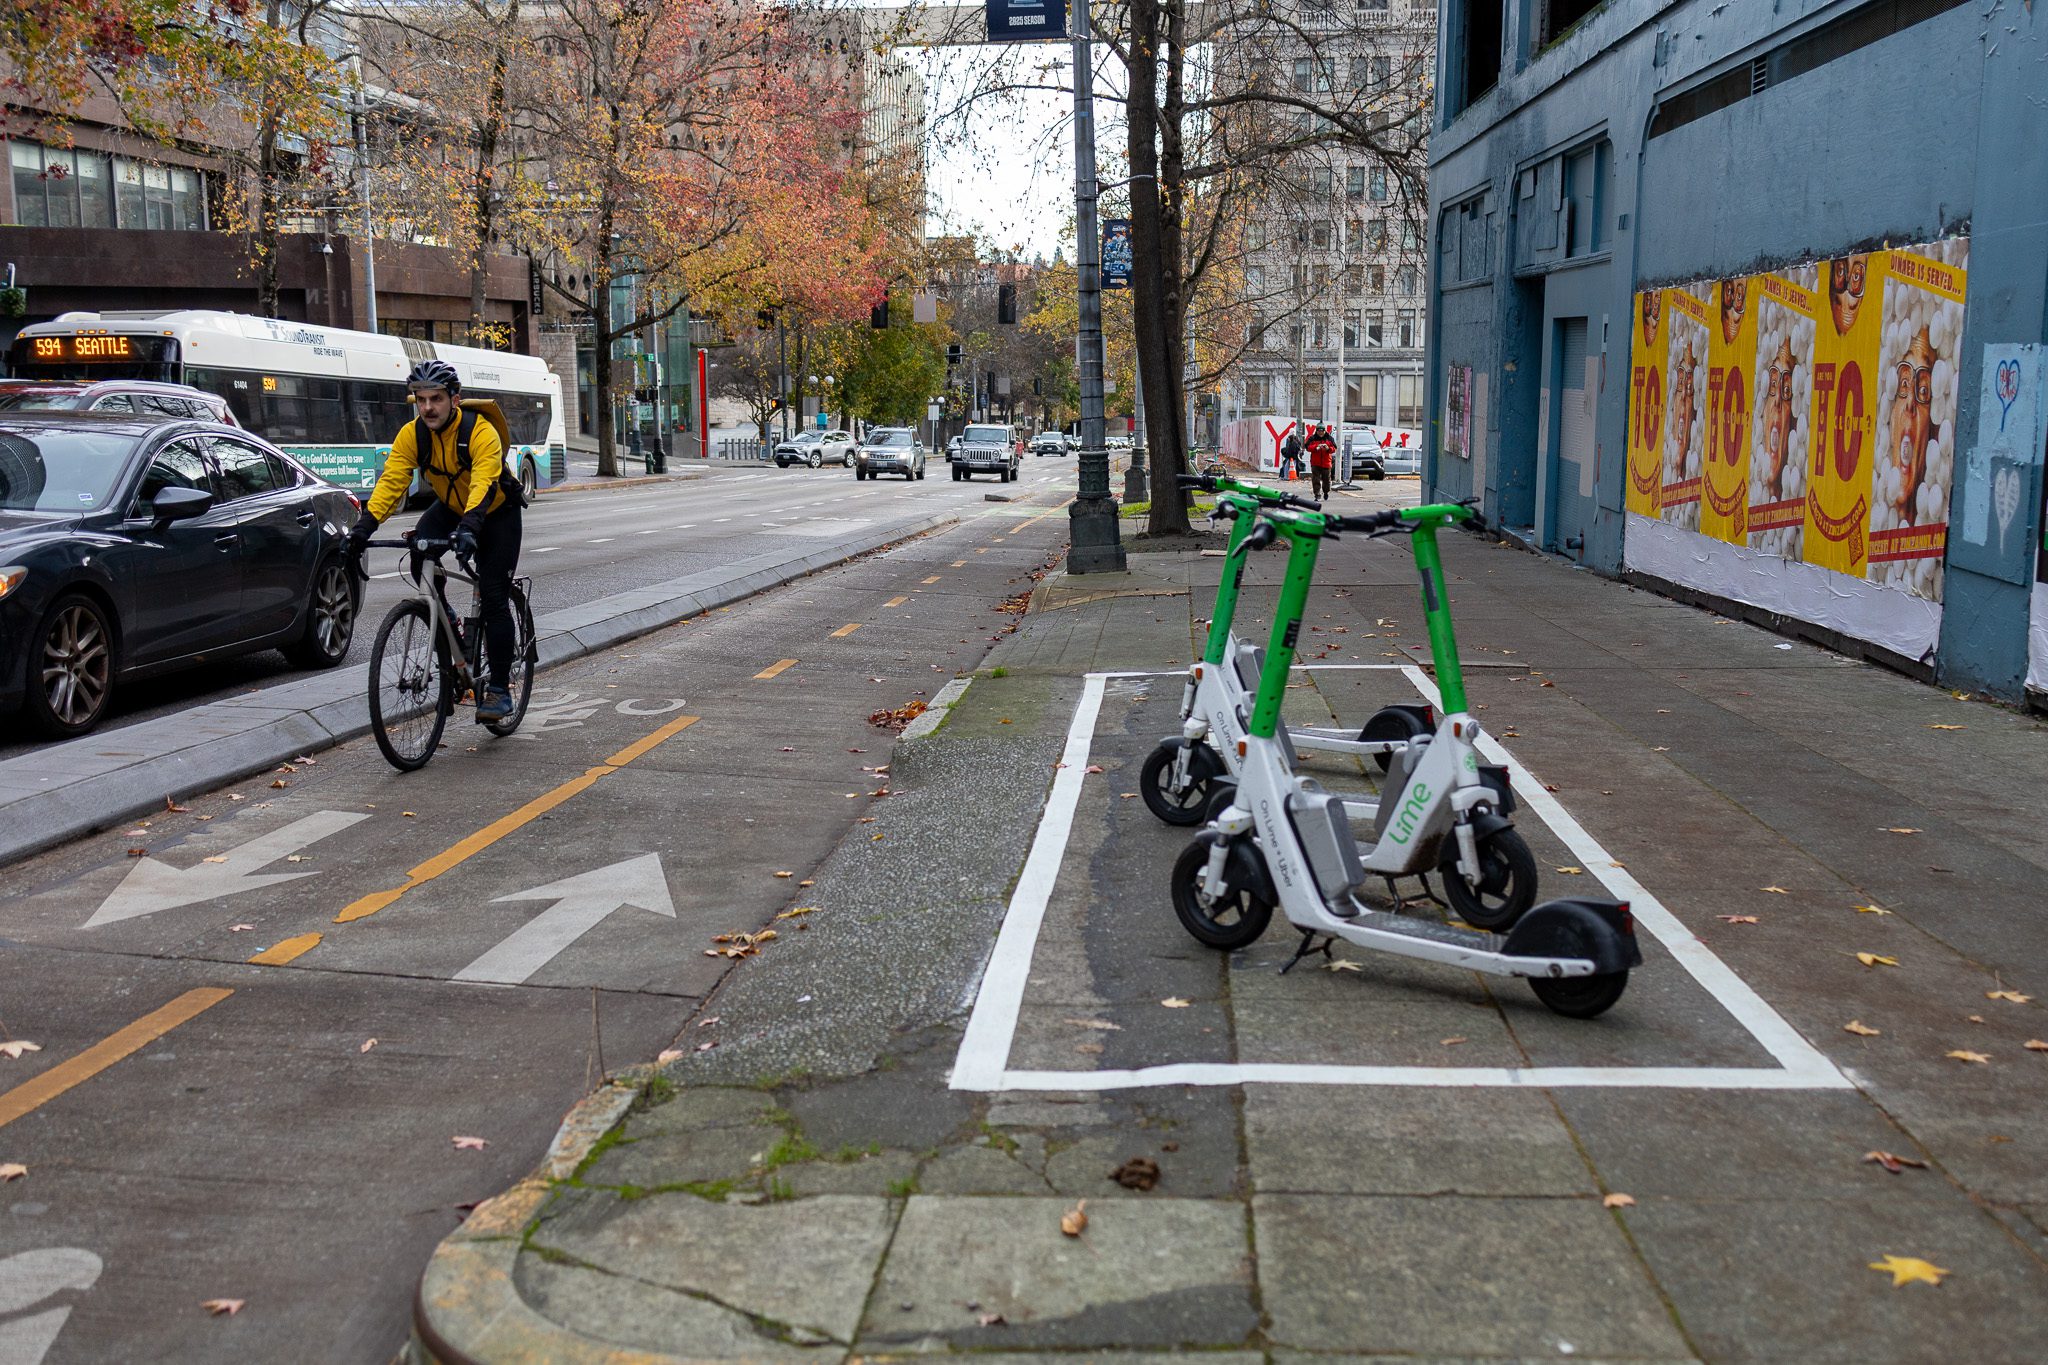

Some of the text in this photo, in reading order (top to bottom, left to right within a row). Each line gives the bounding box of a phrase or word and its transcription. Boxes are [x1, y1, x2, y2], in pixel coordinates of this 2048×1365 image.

[1009, 15, 1046, 26] 2025 SEASON
[1890, 254, 1916, 279] DINNER
[1917, 264, 1925, 282] IS
[533, 262, 541, 314] ARBUCKS
[1764, 277, 1782, 298] DINNER
[36, 337, 129, 355] 594 SEATTLE
[313, 346, 344, 358] RIDE THE WAVE
[297, 453, 306, 464] Get
[310, 453, 323, 464] Good
[323, 453, 328, 464] To
[328, 453, 337, 464] Go!
[337, 455, 347, 465] pass
[347, 454, 353, 464] to
[353, 455, 364, 464] save
[320, 467, 337, 477] express
[345, 465, 359, 475] lanes.
[1388, 782, 1432, 845] Lime
[1278, 856, 1293, 888] Uber
